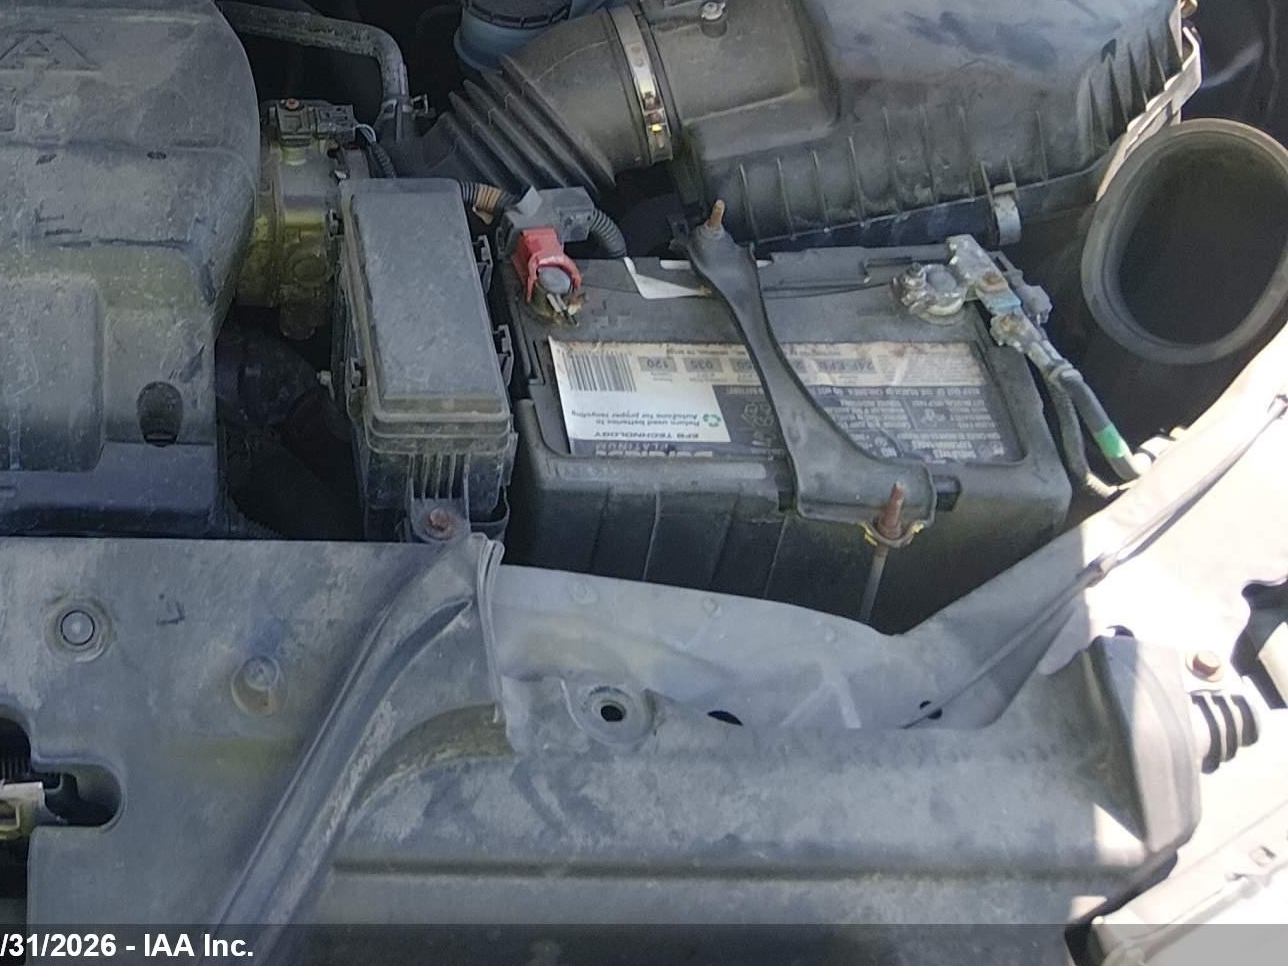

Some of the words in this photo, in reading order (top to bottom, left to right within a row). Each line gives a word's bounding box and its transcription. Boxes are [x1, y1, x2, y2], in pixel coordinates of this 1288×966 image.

[610, 411, 640, 420] proper
[656, 413, 698, 421] AutoZone
[607, 419, 645, 427] batteries
[594, 431, 673, 440] TECHNOLOGY
[595, 442, 669, 450] PLATINUM
